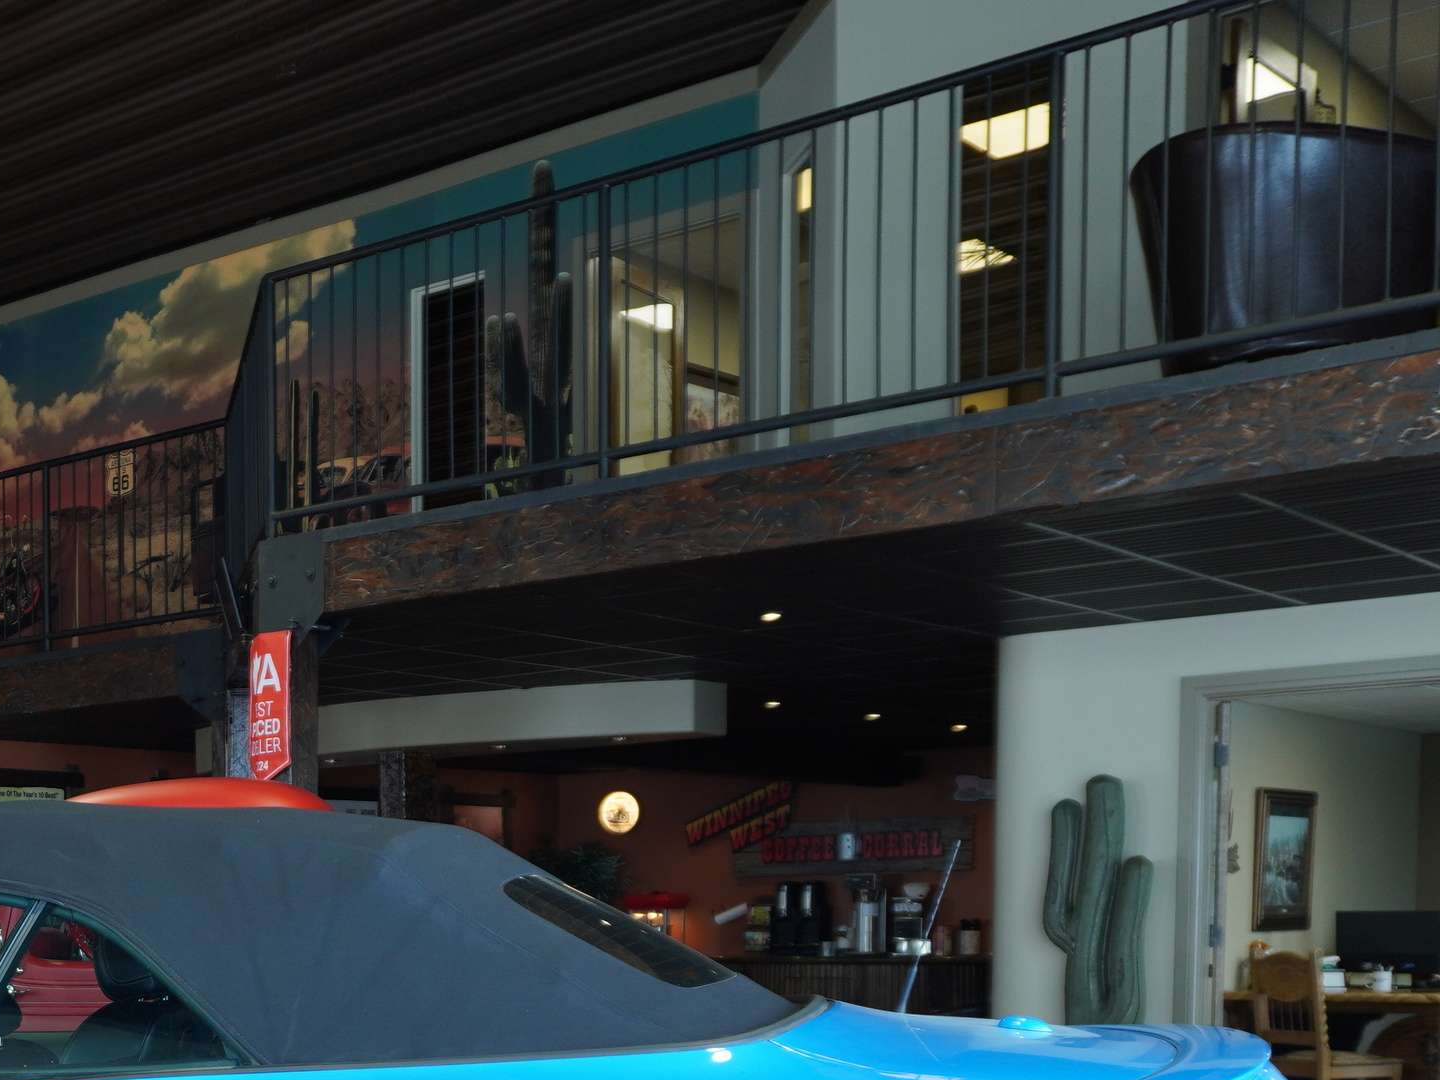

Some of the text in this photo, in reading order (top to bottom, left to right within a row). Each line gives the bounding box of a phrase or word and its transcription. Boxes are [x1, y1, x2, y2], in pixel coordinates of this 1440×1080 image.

[729, 803, 792, 851] WEST
[760, 831, 943, 864] COFFEE CORRAL
